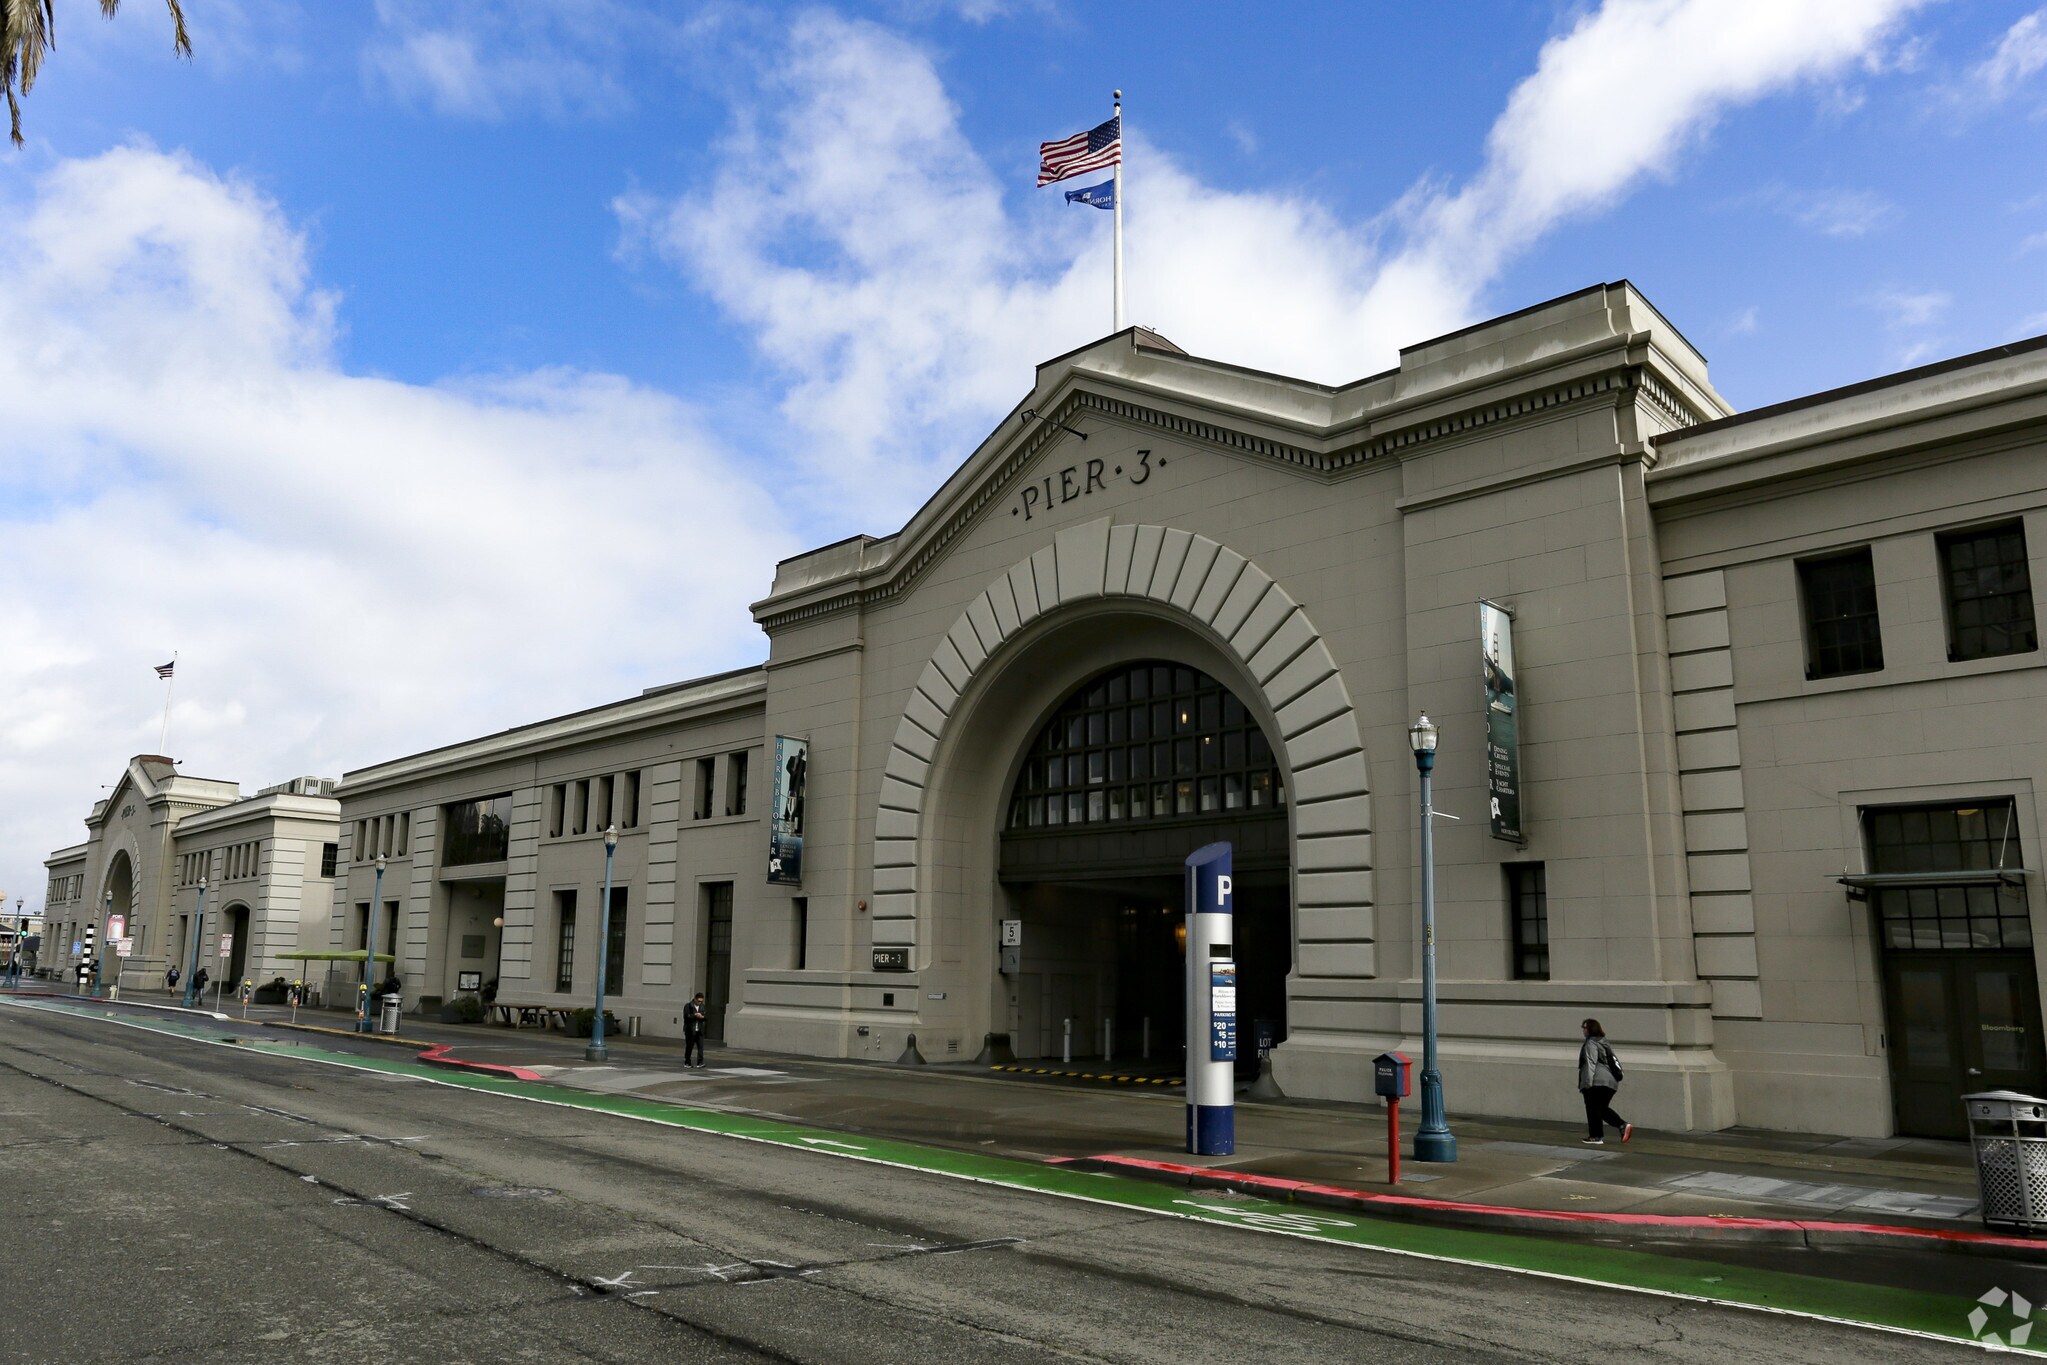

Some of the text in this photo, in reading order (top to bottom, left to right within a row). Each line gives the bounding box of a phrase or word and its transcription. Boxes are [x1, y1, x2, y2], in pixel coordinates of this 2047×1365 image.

[770, 742, 783, 855] HORNBLOWER
[1217, 875, 1232, 906] P
[1009, 926, 1014, 937] 5
[874, 953, 889, 963] PIER
[897, 953, 902, 963] 3
[1213, 1021, 1227, 1030] $20
[1981, 1024, 2024, 1033] Bloomberg
[1218, 1031, 1227, 1039] $5
[1214, 1040, 1227, 1049] $10
[1259, 1037, 1272, 1047] LOT
